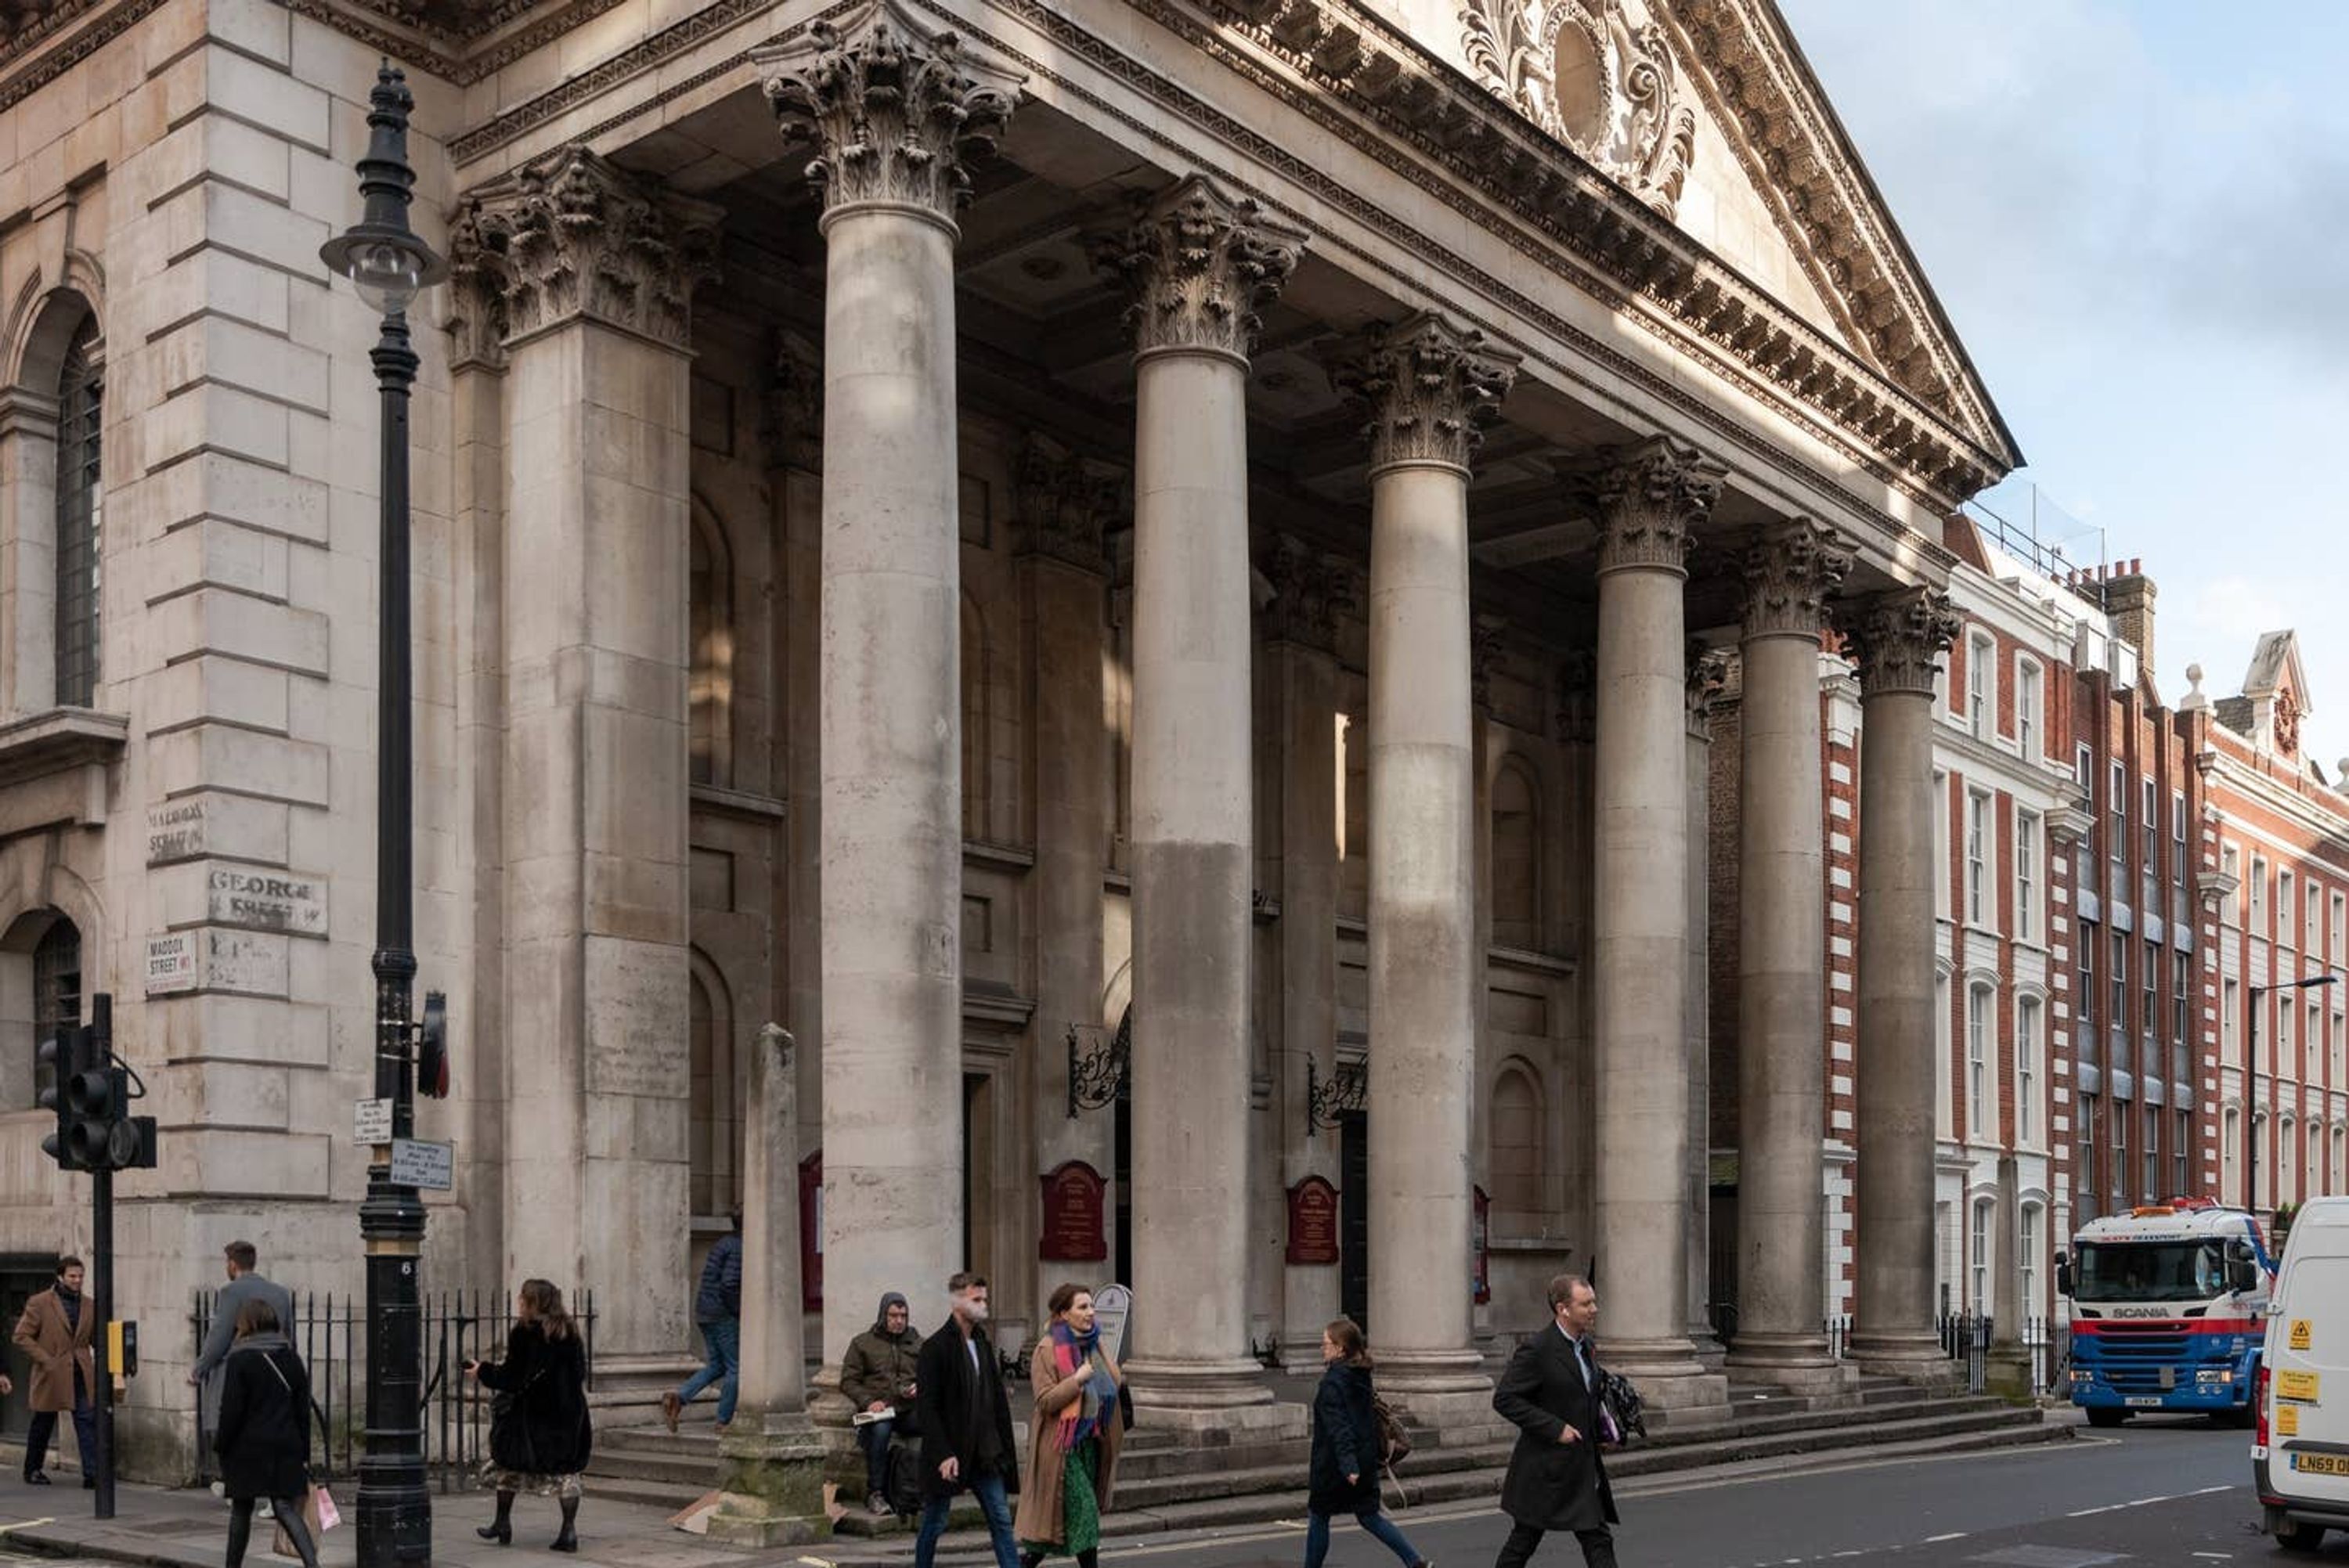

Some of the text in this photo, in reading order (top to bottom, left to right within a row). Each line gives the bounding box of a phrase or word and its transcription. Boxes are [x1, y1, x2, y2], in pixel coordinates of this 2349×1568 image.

[150, 938, 182, 956] MADDOX
[150, 957, 177, 975] STREET
[402, 1261, 412, 1274] 6
[2112, 1307, 2170, 1319] SCANIA
[2298, 1455, 2334, 1472] LN69
